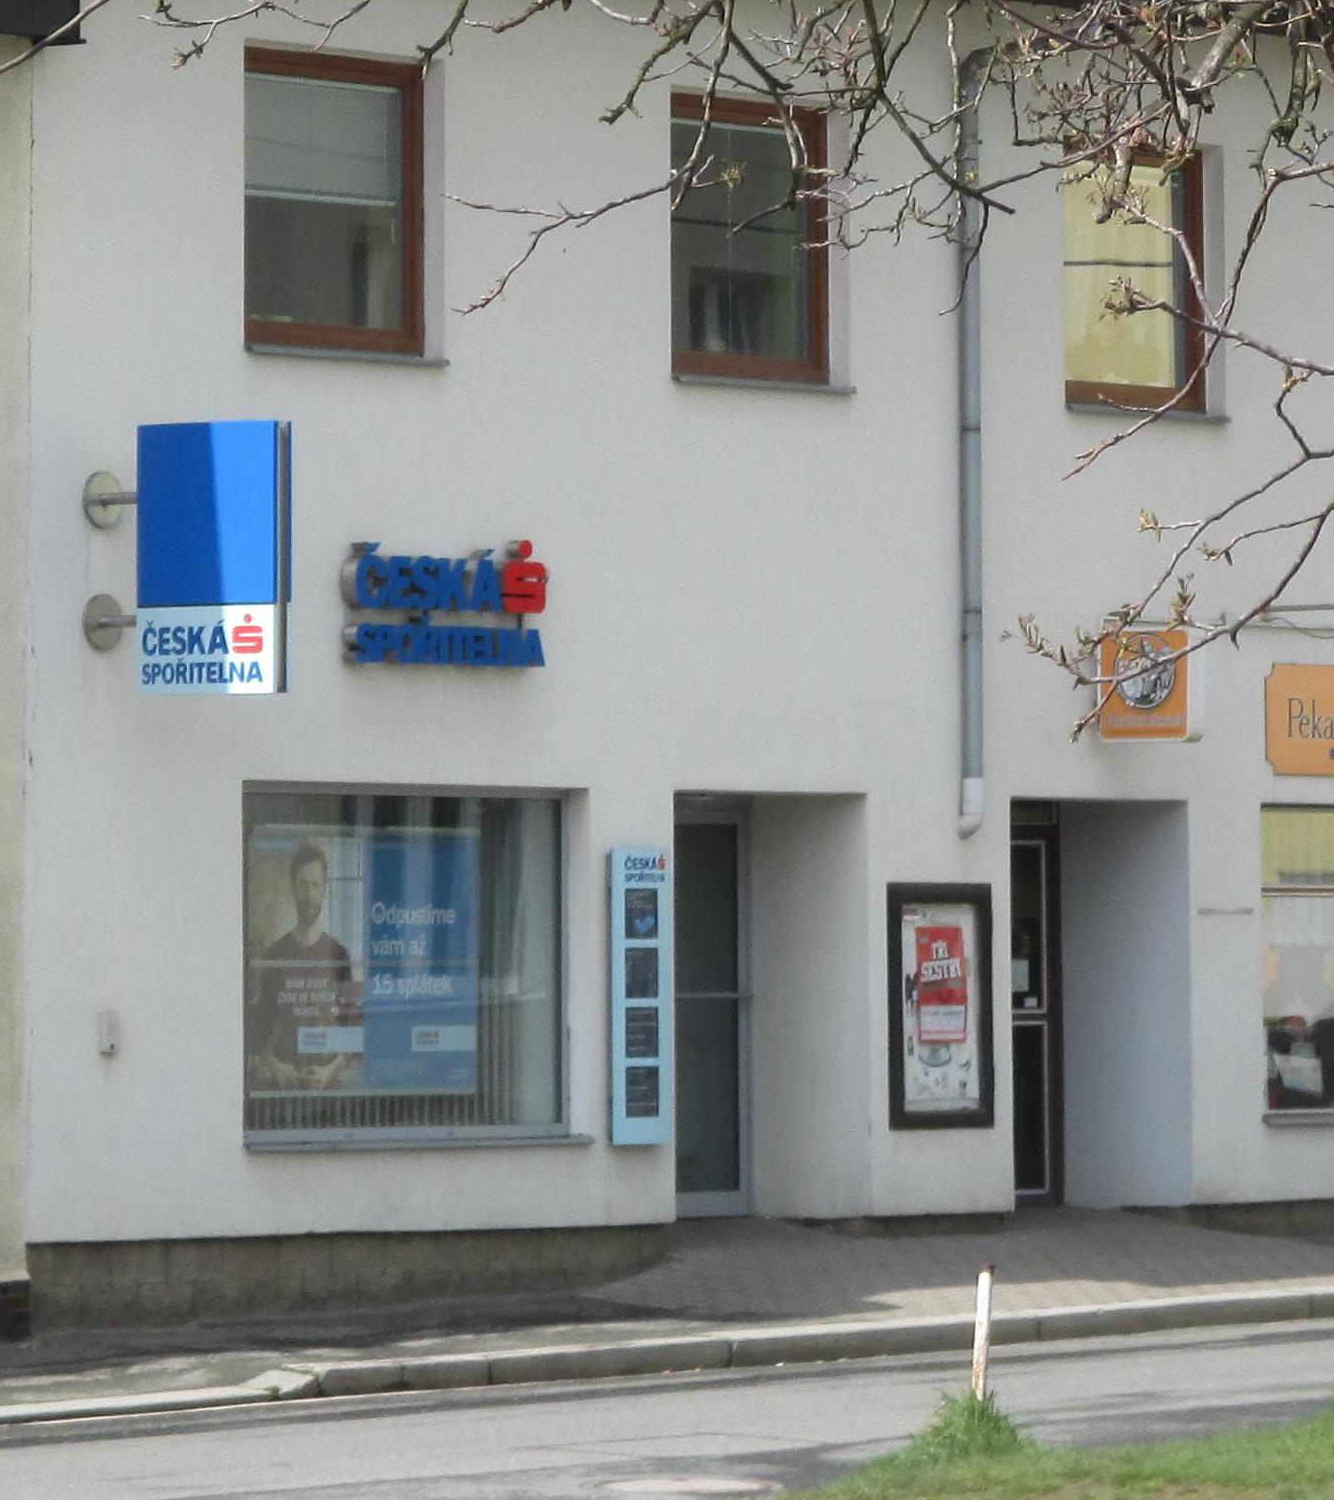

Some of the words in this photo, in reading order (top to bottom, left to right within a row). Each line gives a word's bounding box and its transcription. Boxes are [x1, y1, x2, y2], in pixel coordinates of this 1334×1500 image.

[350, 542, 502, 613] ČESKÁ
[141, 620, 229, 656] ČESKÁ
[342, 612, 545, 668] SPOŘITELNA
[142, 659, 264, 685] SPOŘITELNA
[373, 973, 394, 994] 15
